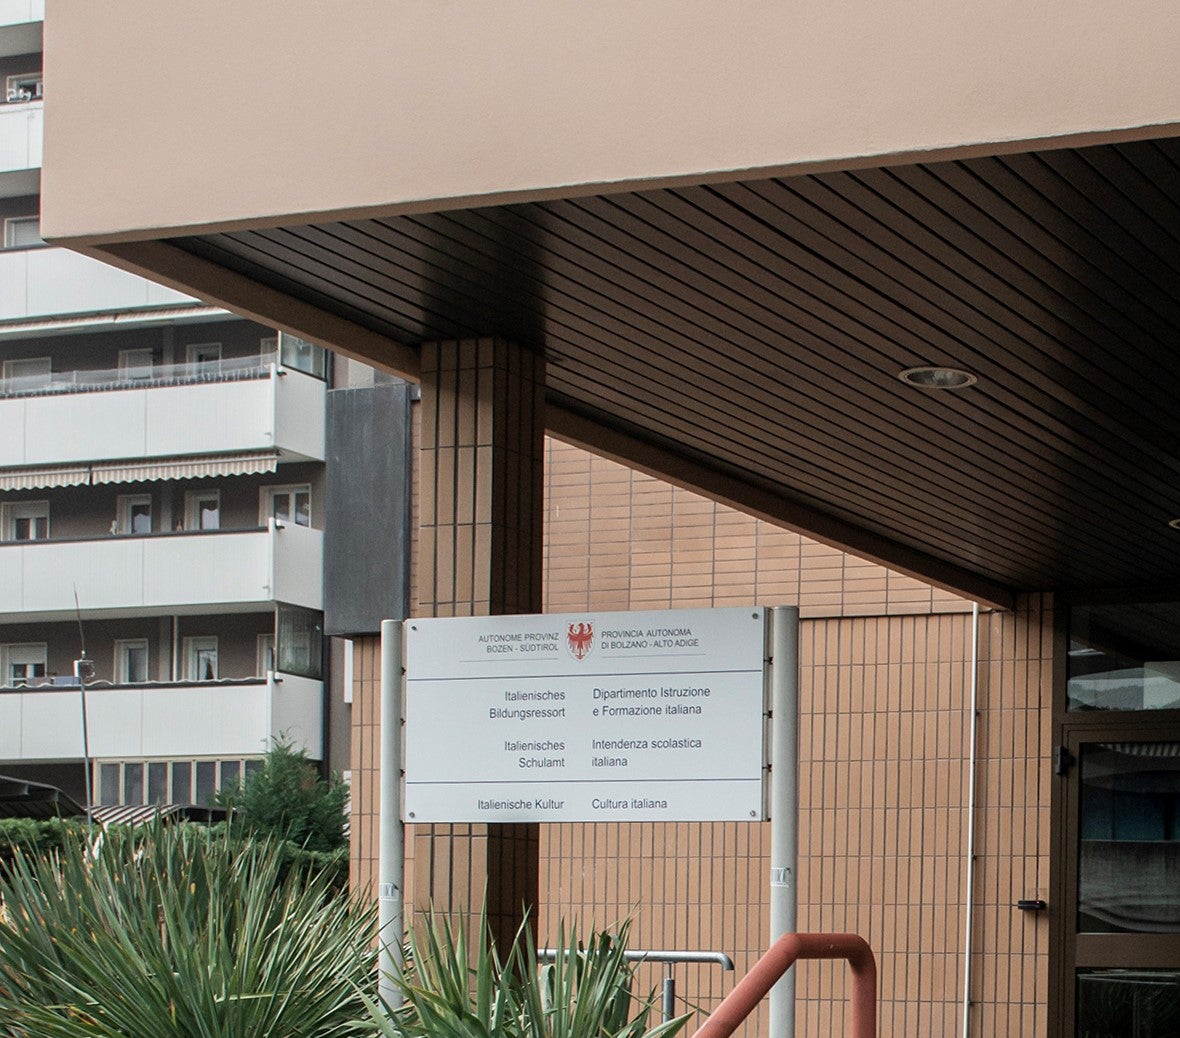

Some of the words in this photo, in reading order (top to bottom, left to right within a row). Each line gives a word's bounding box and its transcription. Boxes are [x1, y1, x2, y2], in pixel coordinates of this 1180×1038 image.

[478, 634, 522, 642] AUTONOME
[524, 632, 559, 641] PROVINZ
[601, 630, 644, 638] PROVINCIA
[647, 628, 692, 637] AUTONOMA
[486, 644, 513, 653] BOZEN
[520, 642, 558, 652] SÜDTIROL
[601, 641, 609, 649] DI
[610, 640, 648, 649] BOLZANO
[653, 640, 674, 648] ALTO
[675, 638, 699, 647] ADIGE
[505, 690, 566, 702] Italienisches
[593, 687, 658, 700] Dipartimento
[661, 686, 711, 697] Istruzione
[490, 707, 566, 721] Bildungsressort
[593, 708, 599, 716] e
[602, 705, 662, 716] Formazione
[665, 704, 702, 715] italiana
[505, 740, 565, 751] Italienisches
[592, 738, 648, 750] Intendenza
[651, 737, 702, 748] scolastica
[519, 756, 565, 768] Schulamt
[592, 756, 628, 767] italiana
[477, 799, 532, 810] Italienische
[535, 799, 564, 810] Kultur
[592, 798, 629, 809] Cultura
[631, 798, 667, 809] italiana
